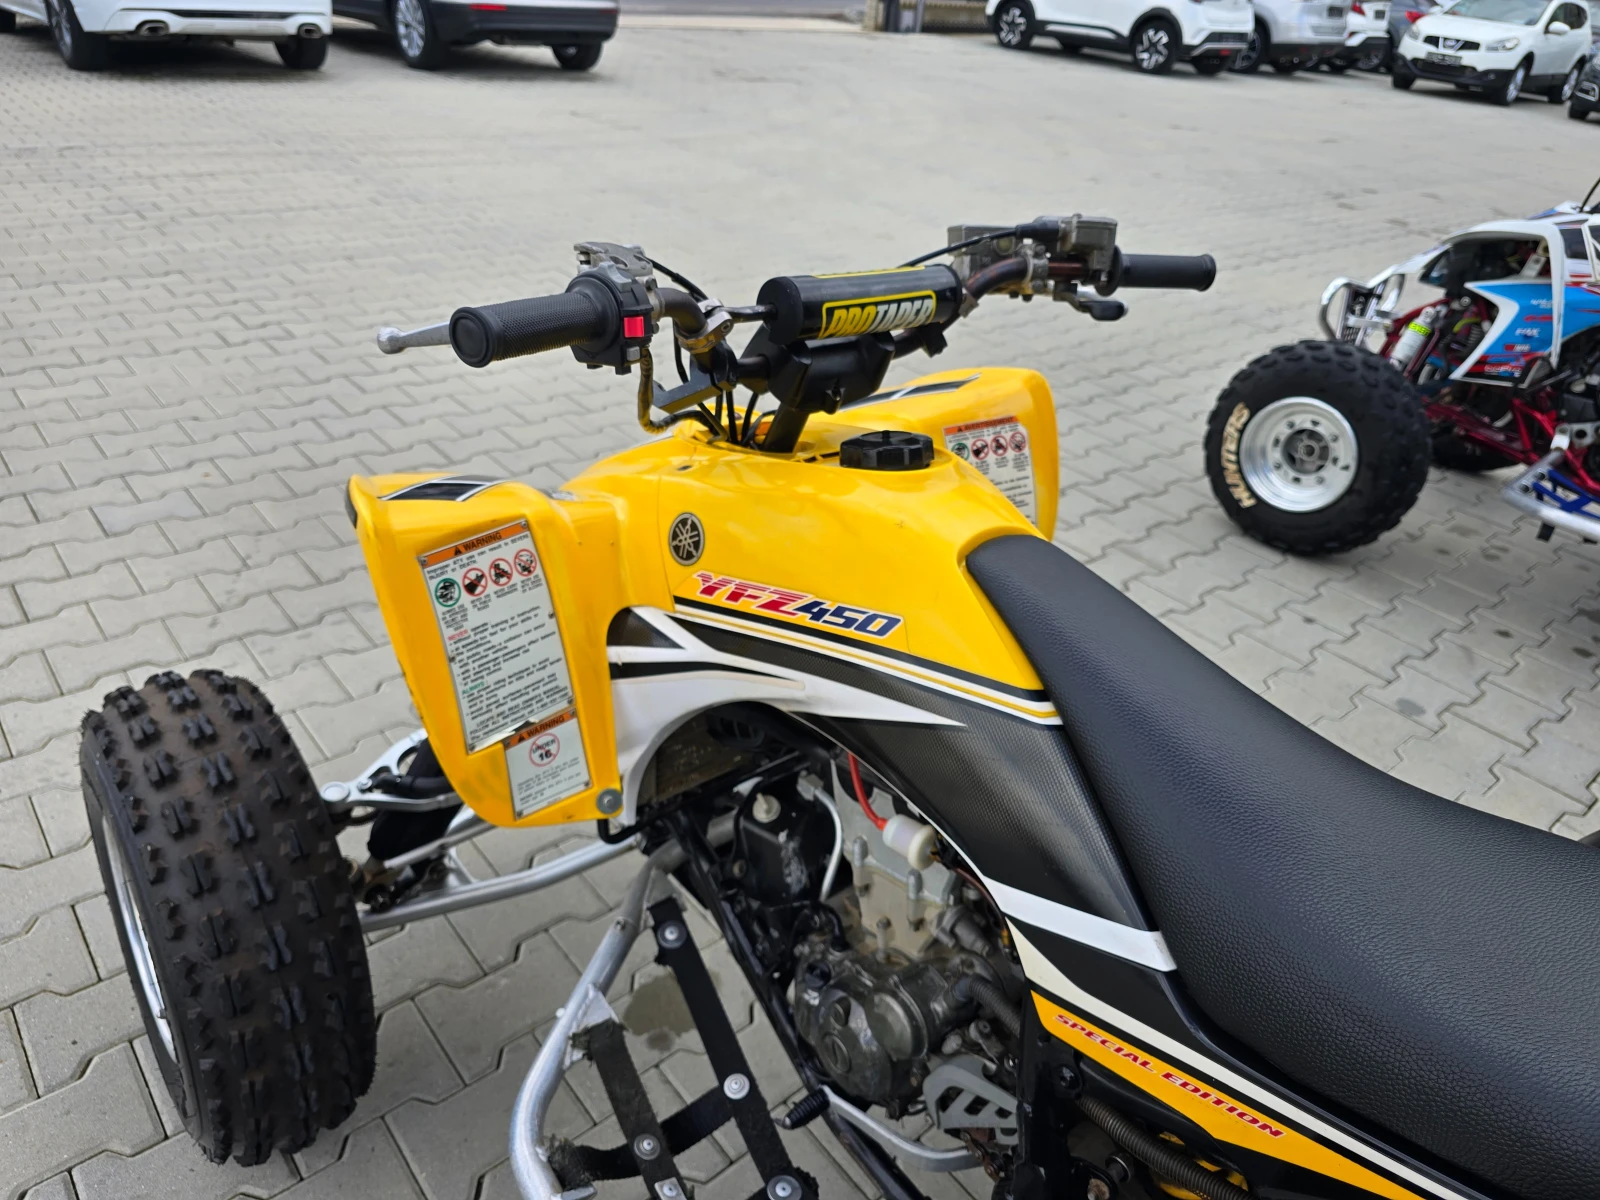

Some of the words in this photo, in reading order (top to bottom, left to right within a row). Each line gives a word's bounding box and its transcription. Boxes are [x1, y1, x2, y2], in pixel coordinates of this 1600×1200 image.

[824, 299, 934, 337] PROTAPER
[463, 532, 502, 551] WARNING
[695, 571, 902, 637] YFZ450
[527, 715, 565, 737] WARNING
[1054, 1014, 1156, 1074] SPECIAL
[1160, 1071, 1287, 1138] EDITION
